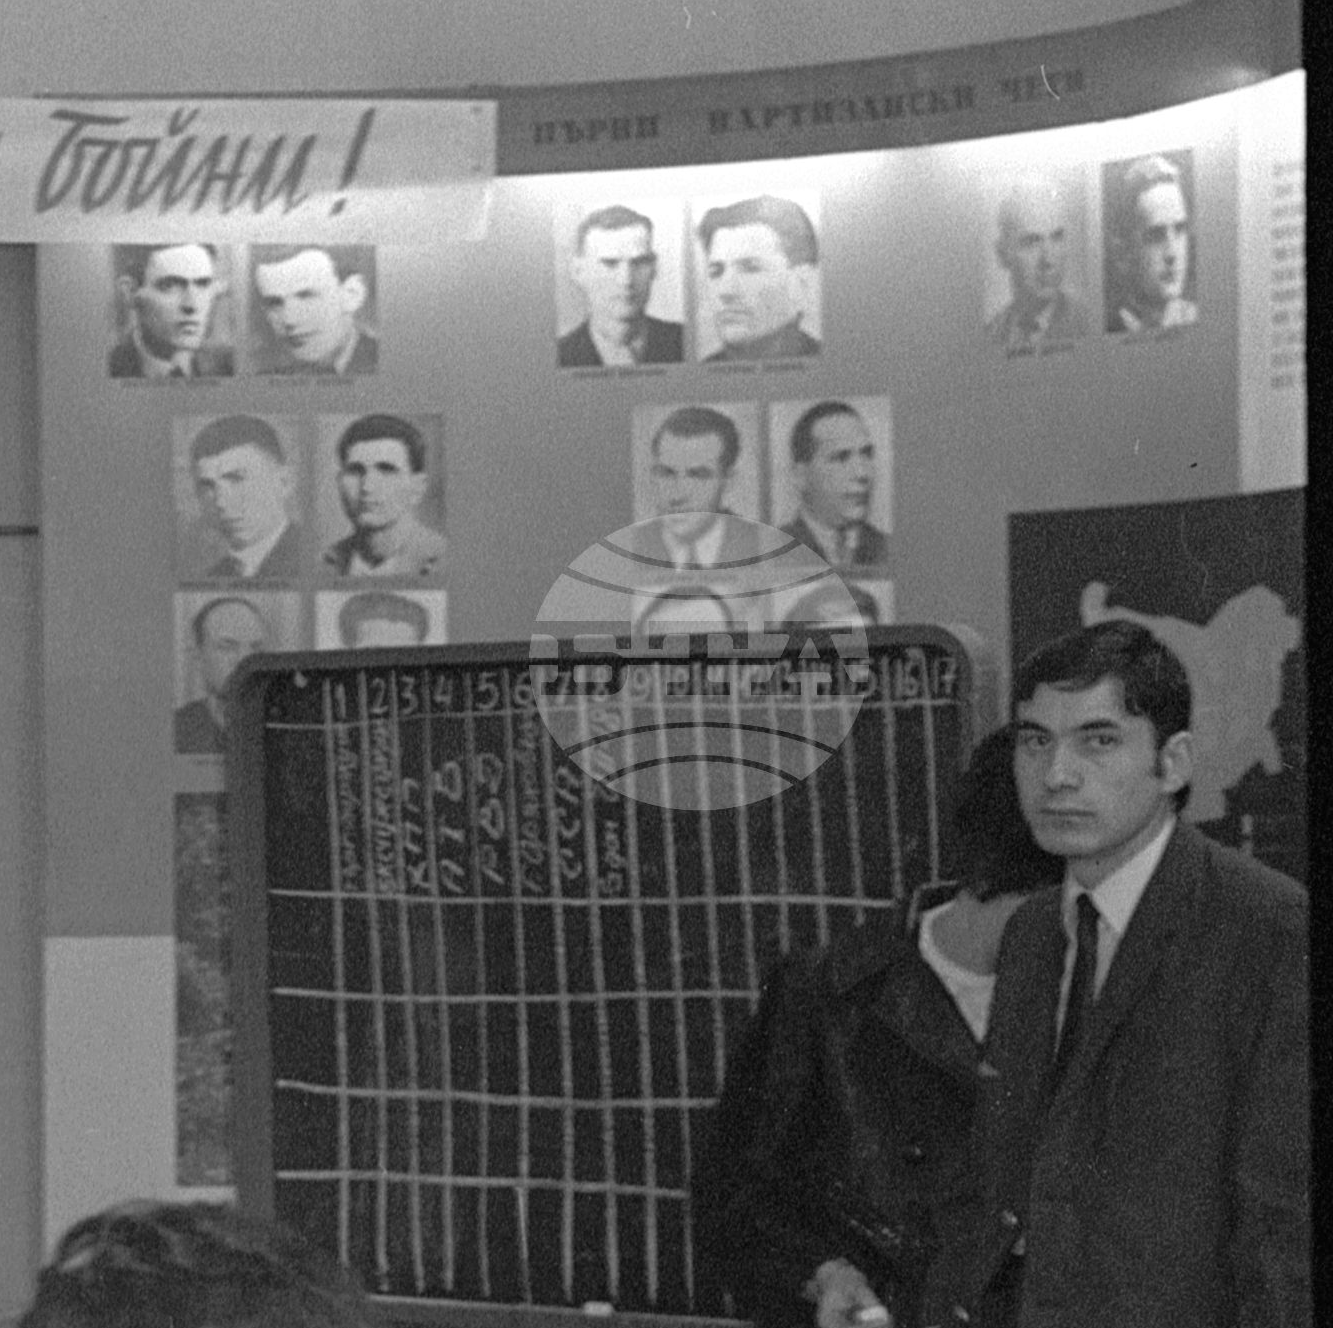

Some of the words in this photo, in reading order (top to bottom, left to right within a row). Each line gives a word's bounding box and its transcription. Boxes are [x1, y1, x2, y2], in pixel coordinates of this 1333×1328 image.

[33, 105, 377, 217] бойни!
[335, 682, 347, 719] 1
[371, 676, 390, 715] 2
[400, 675, 419, 715] 3
[433, 674, 453, 709] 4
[478, 671, 501, 711] 5
[512, 671, 536, 708] 6
